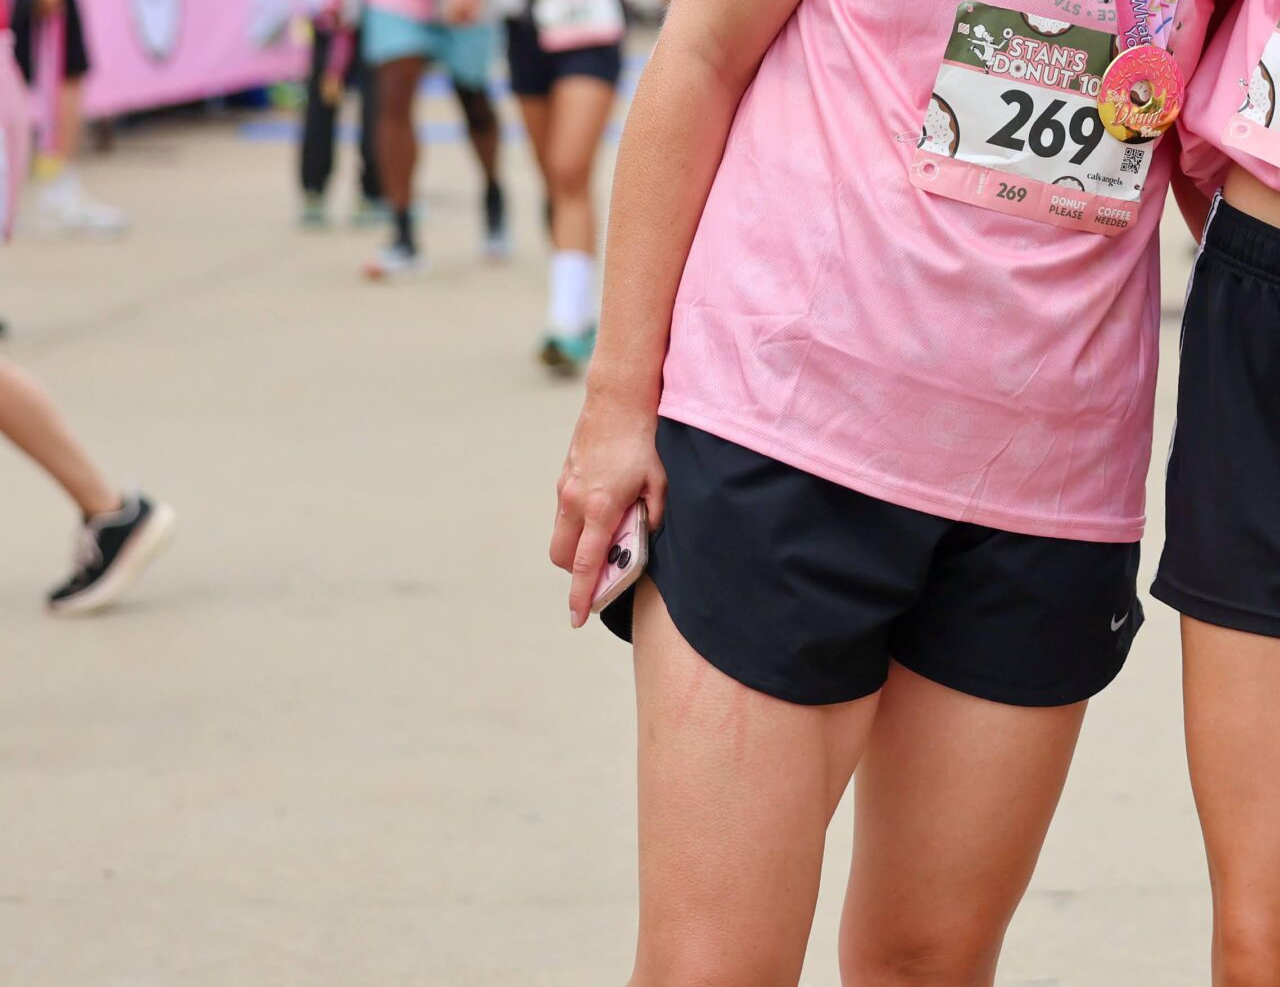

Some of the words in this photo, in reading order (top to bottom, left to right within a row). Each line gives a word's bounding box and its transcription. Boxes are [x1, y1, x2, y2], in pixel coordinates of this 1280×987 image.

[1009, 38, 1085, 72] STAN'S
[992, 54, 1074, 88] DONUT
[1080, 74, 1102, 97] 10
[985, 89, 1105, 165] 269
[995, 182, 1027, 202] 269
[1051, 195, 1087, 210] DONUT
[1049, 204, 1084, 220] PLEASE
[1097, 206, 1132, 221] COFFEE
[1094, 215, 1128, 228] NEEDED
